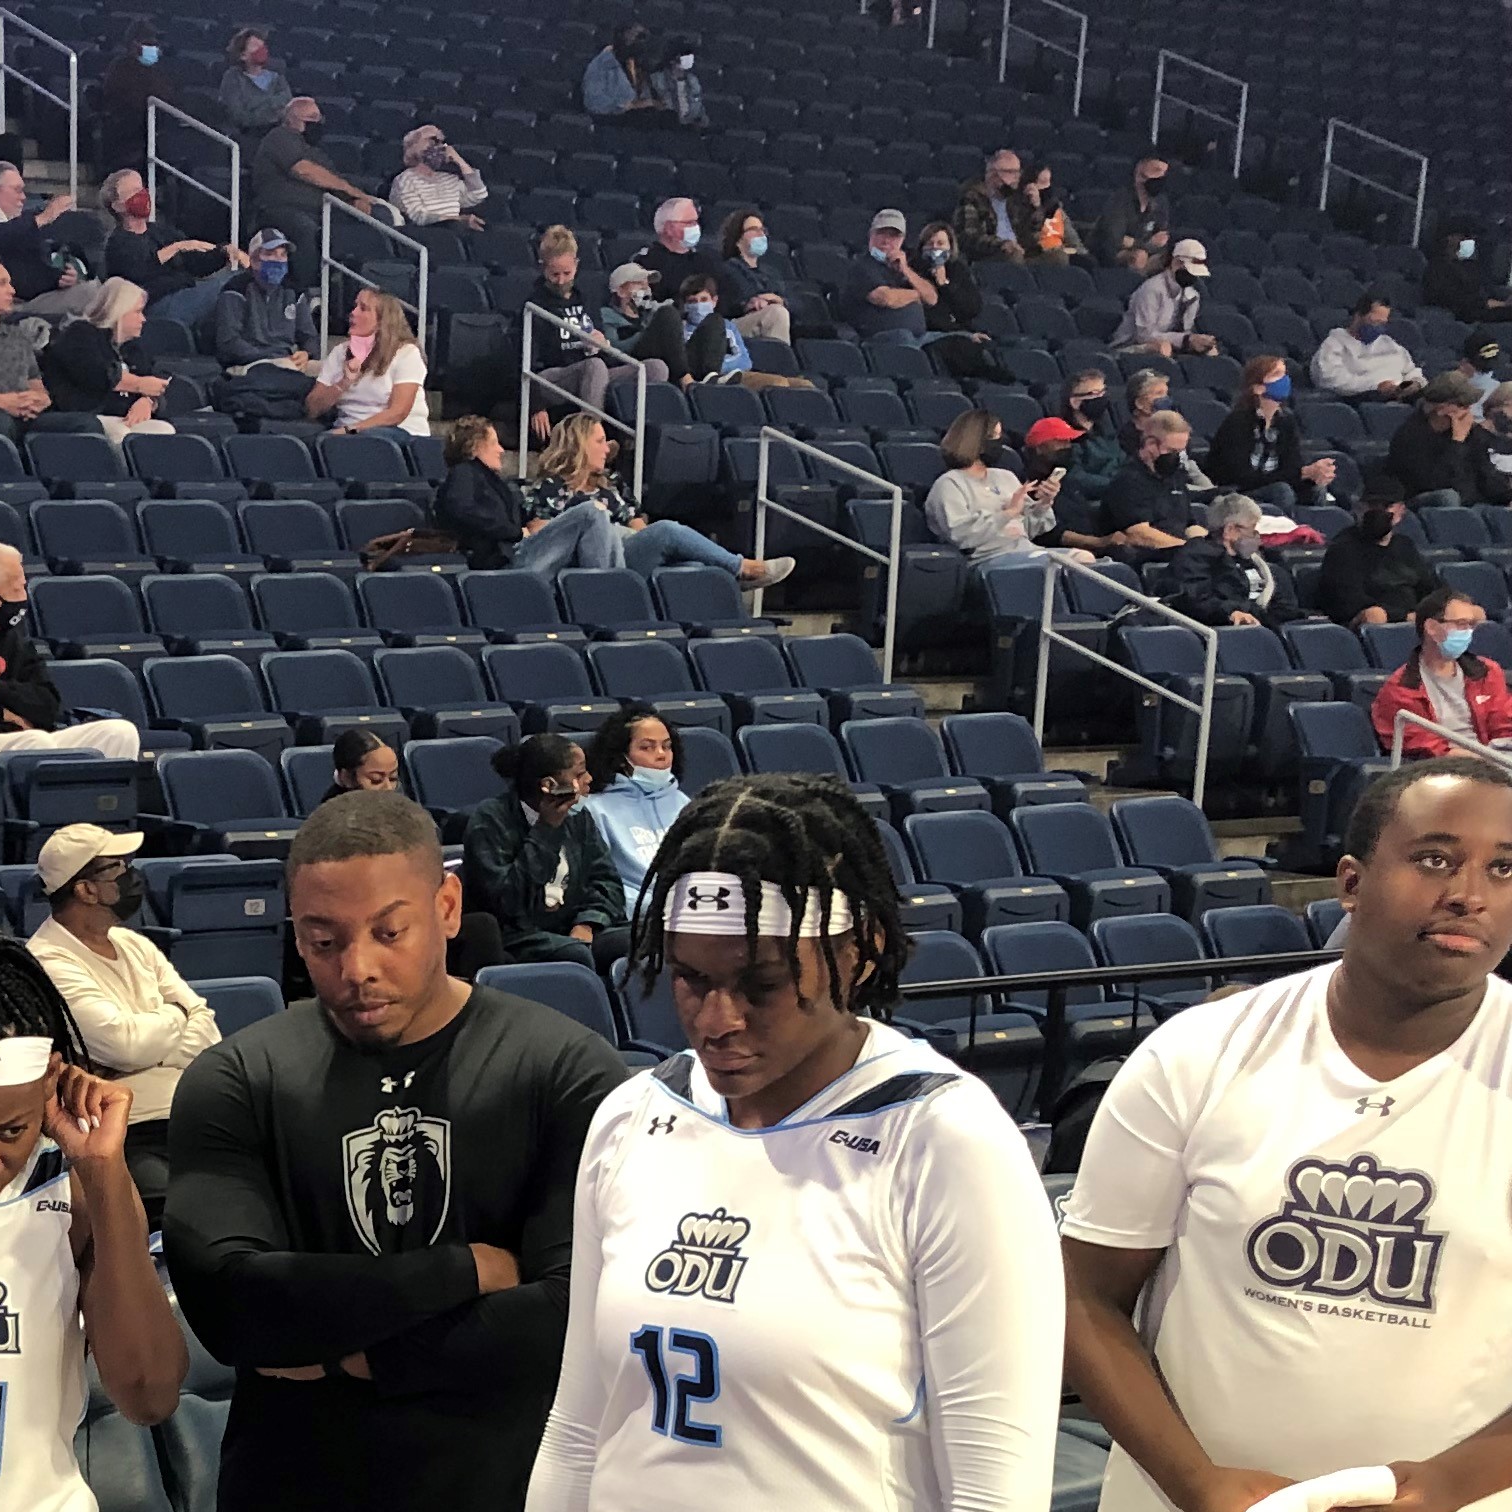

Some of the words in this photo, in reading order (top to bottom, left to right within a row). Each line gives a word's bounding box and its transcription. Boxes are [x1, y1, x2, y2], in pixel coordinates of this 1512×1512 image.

[36, 1200, 71, 1213] C-US
[645, 1248, 749, 1304] ODU
[1244, 1214, 1448, 1312] ODU
[1243, 1286, 1314, 1312] WOMEN'S
[1317, 1301, 1432, 1330] BASKETBALL
[629, 1324, 723, 1448] 12
